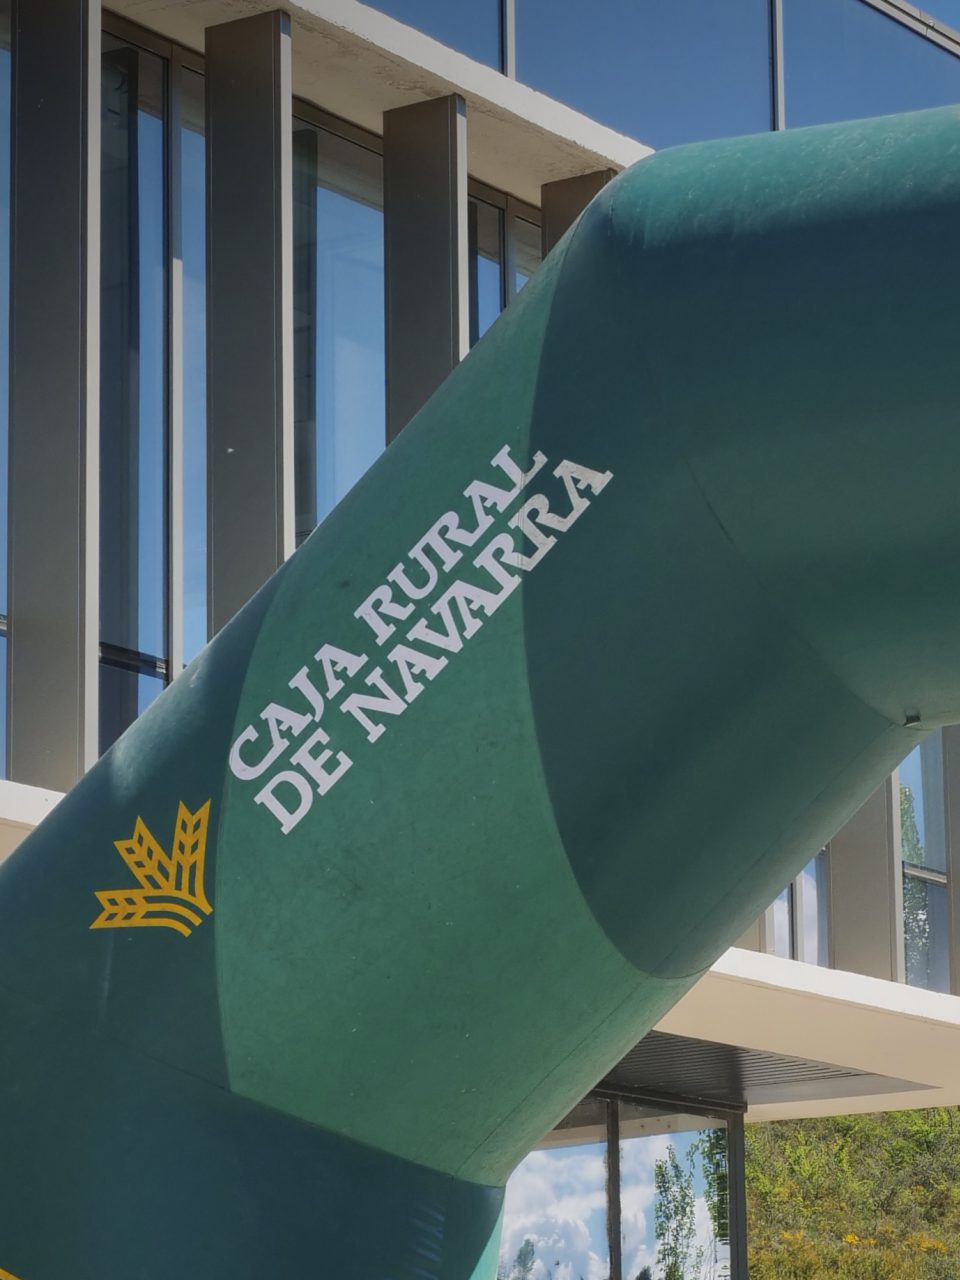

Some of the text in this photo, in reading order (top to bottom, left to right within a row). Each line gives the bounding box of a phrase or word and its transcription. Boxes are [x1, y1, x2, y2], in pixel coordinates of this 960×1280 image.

[228, 444, 548, 781] CAJA RURAL
[253, 459, 614, 835] DE NAVARRA
